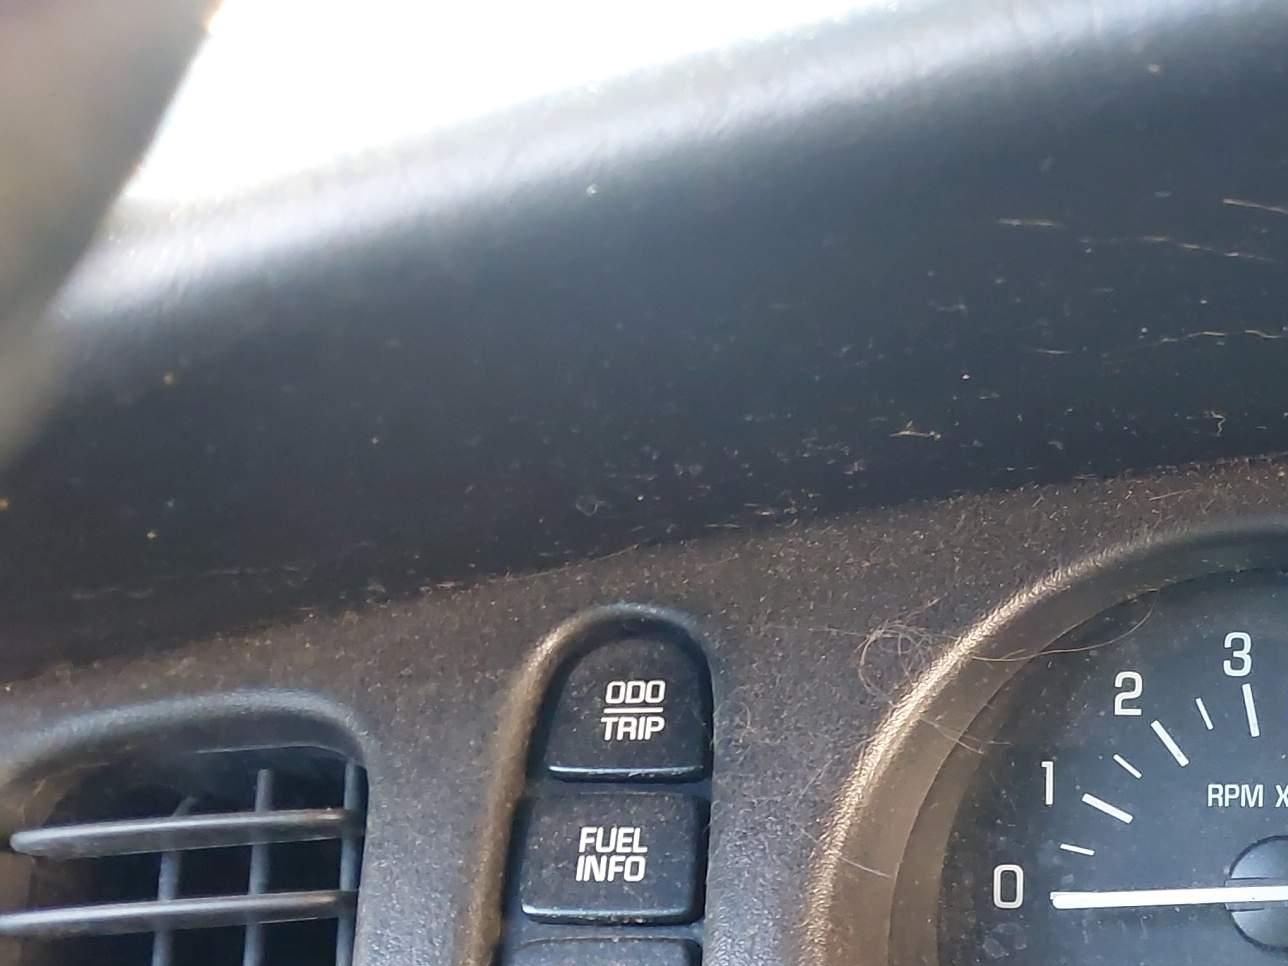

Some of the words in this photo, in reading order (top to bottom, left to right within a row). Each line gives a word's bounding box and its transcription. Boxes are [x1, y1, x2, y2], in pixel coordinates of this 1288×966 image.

[1223, 631, 1252, 677] 3
[605, 680, 666, 704] ODO
[1114, 671, 1143, 716] 2
[600, 716, 665, 741] TRIP
[1041, 761, 1054, 805] 1
[1207, 783, 1264, 808] RPM
[578, 826, 648, 854] FUEL
[575, 854, 646, 882] INFO
[993, 864, 1024, 909] 0
